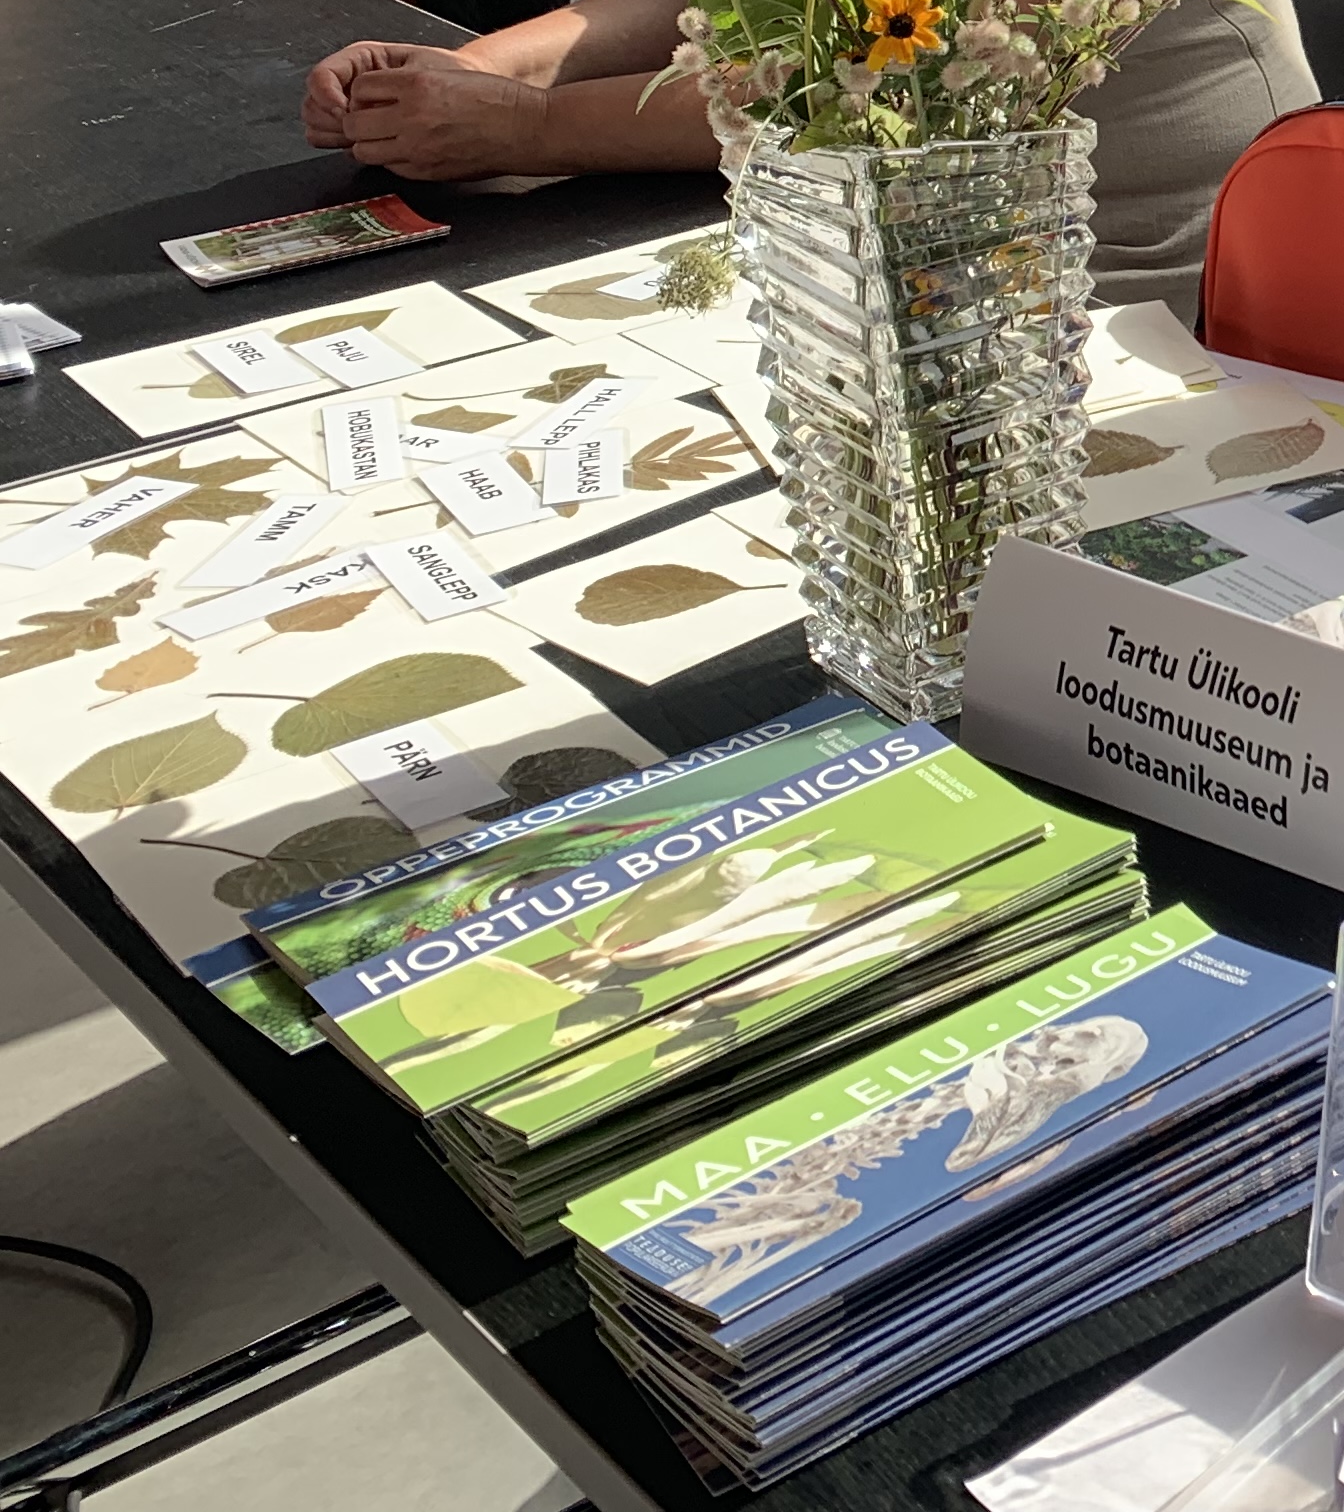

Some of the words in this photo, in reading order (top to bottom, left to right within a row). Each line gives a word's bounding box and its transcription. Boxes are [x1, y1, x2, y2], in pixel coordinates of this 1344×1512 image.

[225, 339, 268, 367] SIREL
[326, 339, 369, 364] PAJU
[573, 388, 623, 417] HALL
[347, 408, 379, 482] HOBUKASTAN
[399, 433, 440, 449] AR
[540, 418, 587, 446] LEPP
[457, 468, 503, 500] HAAB
[576, 440, 601, 494] PIHLAKAS
[69, 487, 164, 529] VAHER
[254, 503, 317, 541] TAMM
[282, 558, 370, 594] KASK
[407, 544, 478, 602] SANGLEPP
[1104, 625, 1179, 681] Tartu
[1187, 647, 1301, 725] Ülikooli
[1055, 661, 1294, 779] loodusmuuseum
[1301, 751, 1330, 794] ja
[383, 739, 442, 782] PÄRN
[1087, 723, 1288, 830] botaanikaaed
[318, 719, 794, 903] ÕPPEPROGRAMMID
[354, 873, 612, 999] HORTUS
[623, 735, 924, 882] BOTANICUS
[617, 1129, 791, 1223] MAA
[842, 1034, 970, 1108] ELU
[1013, 929, 1178, 1021] LUGU
